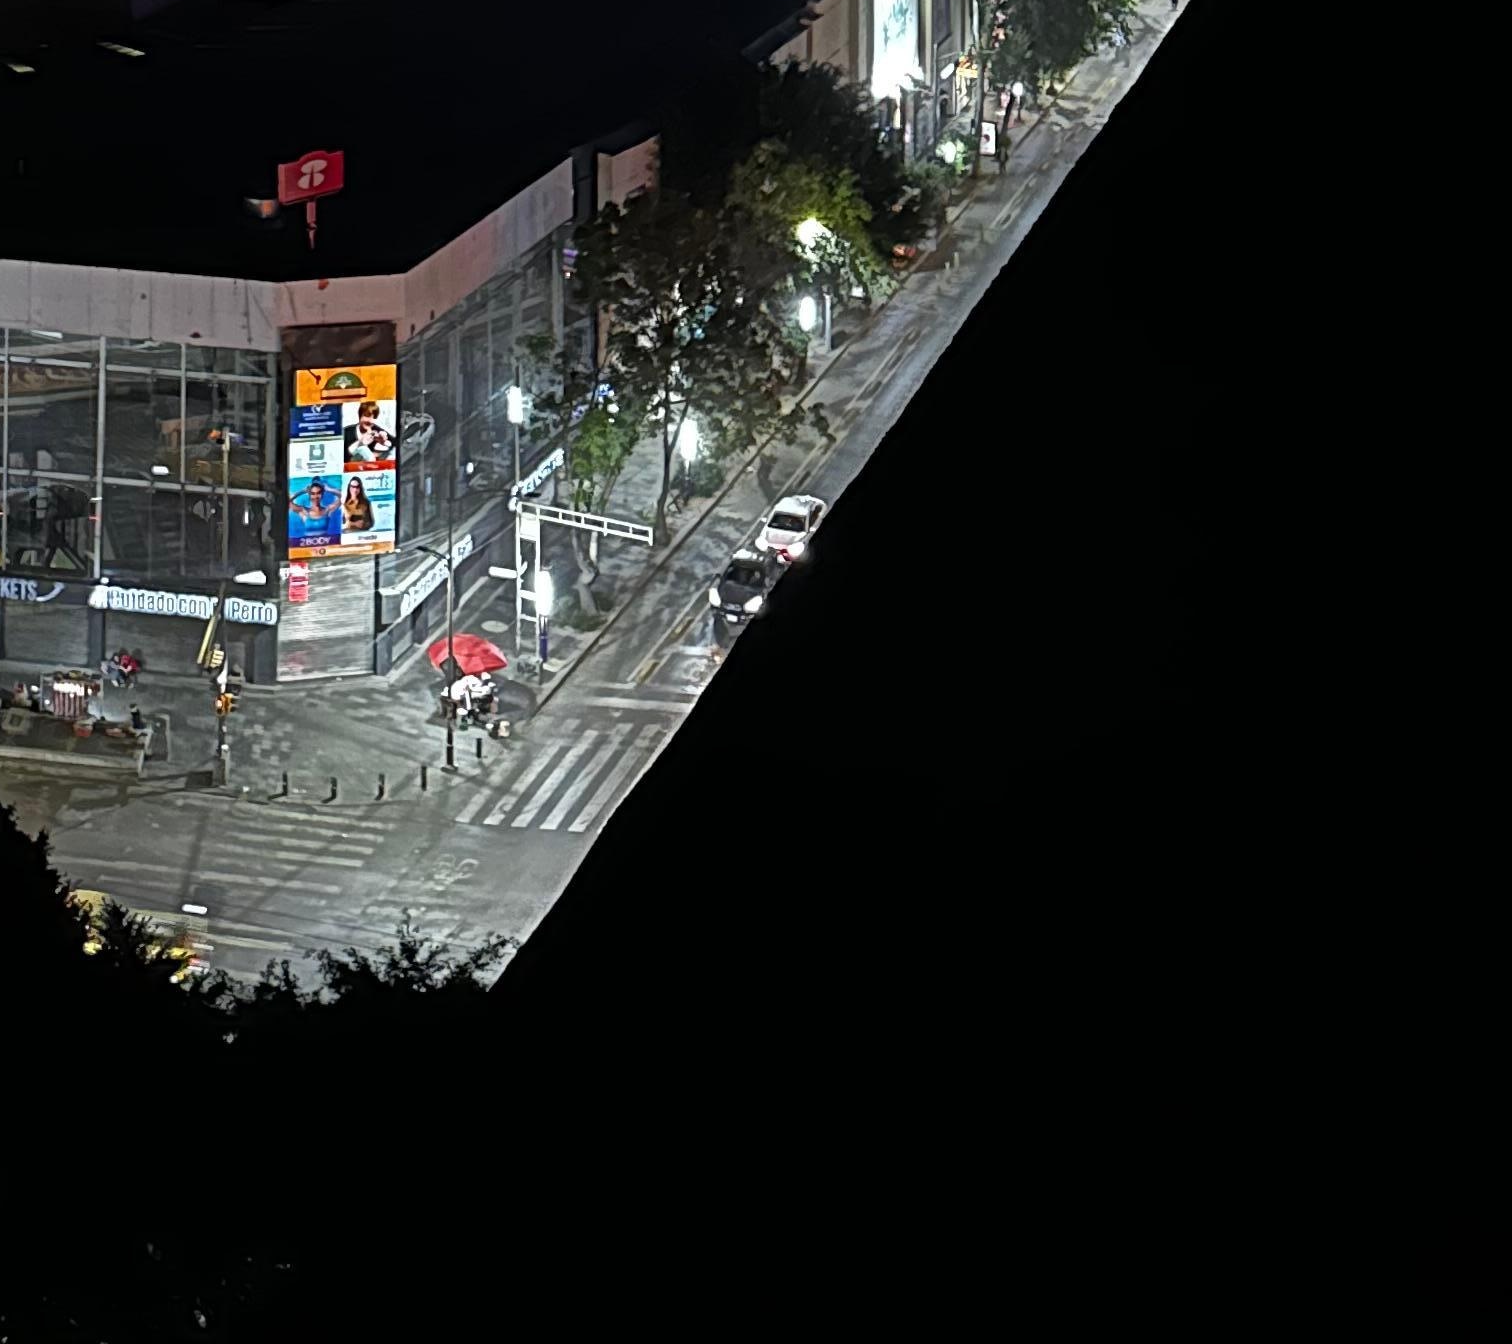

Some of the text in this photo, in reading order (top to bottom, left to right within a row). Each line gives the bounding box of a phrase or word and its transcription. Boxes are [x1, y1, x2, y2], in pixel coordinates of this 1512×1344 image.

[109, 587, 174, 613] Cuidado
[178, 596, 207, 617] con
[231, 600, 273, 623] Perro
